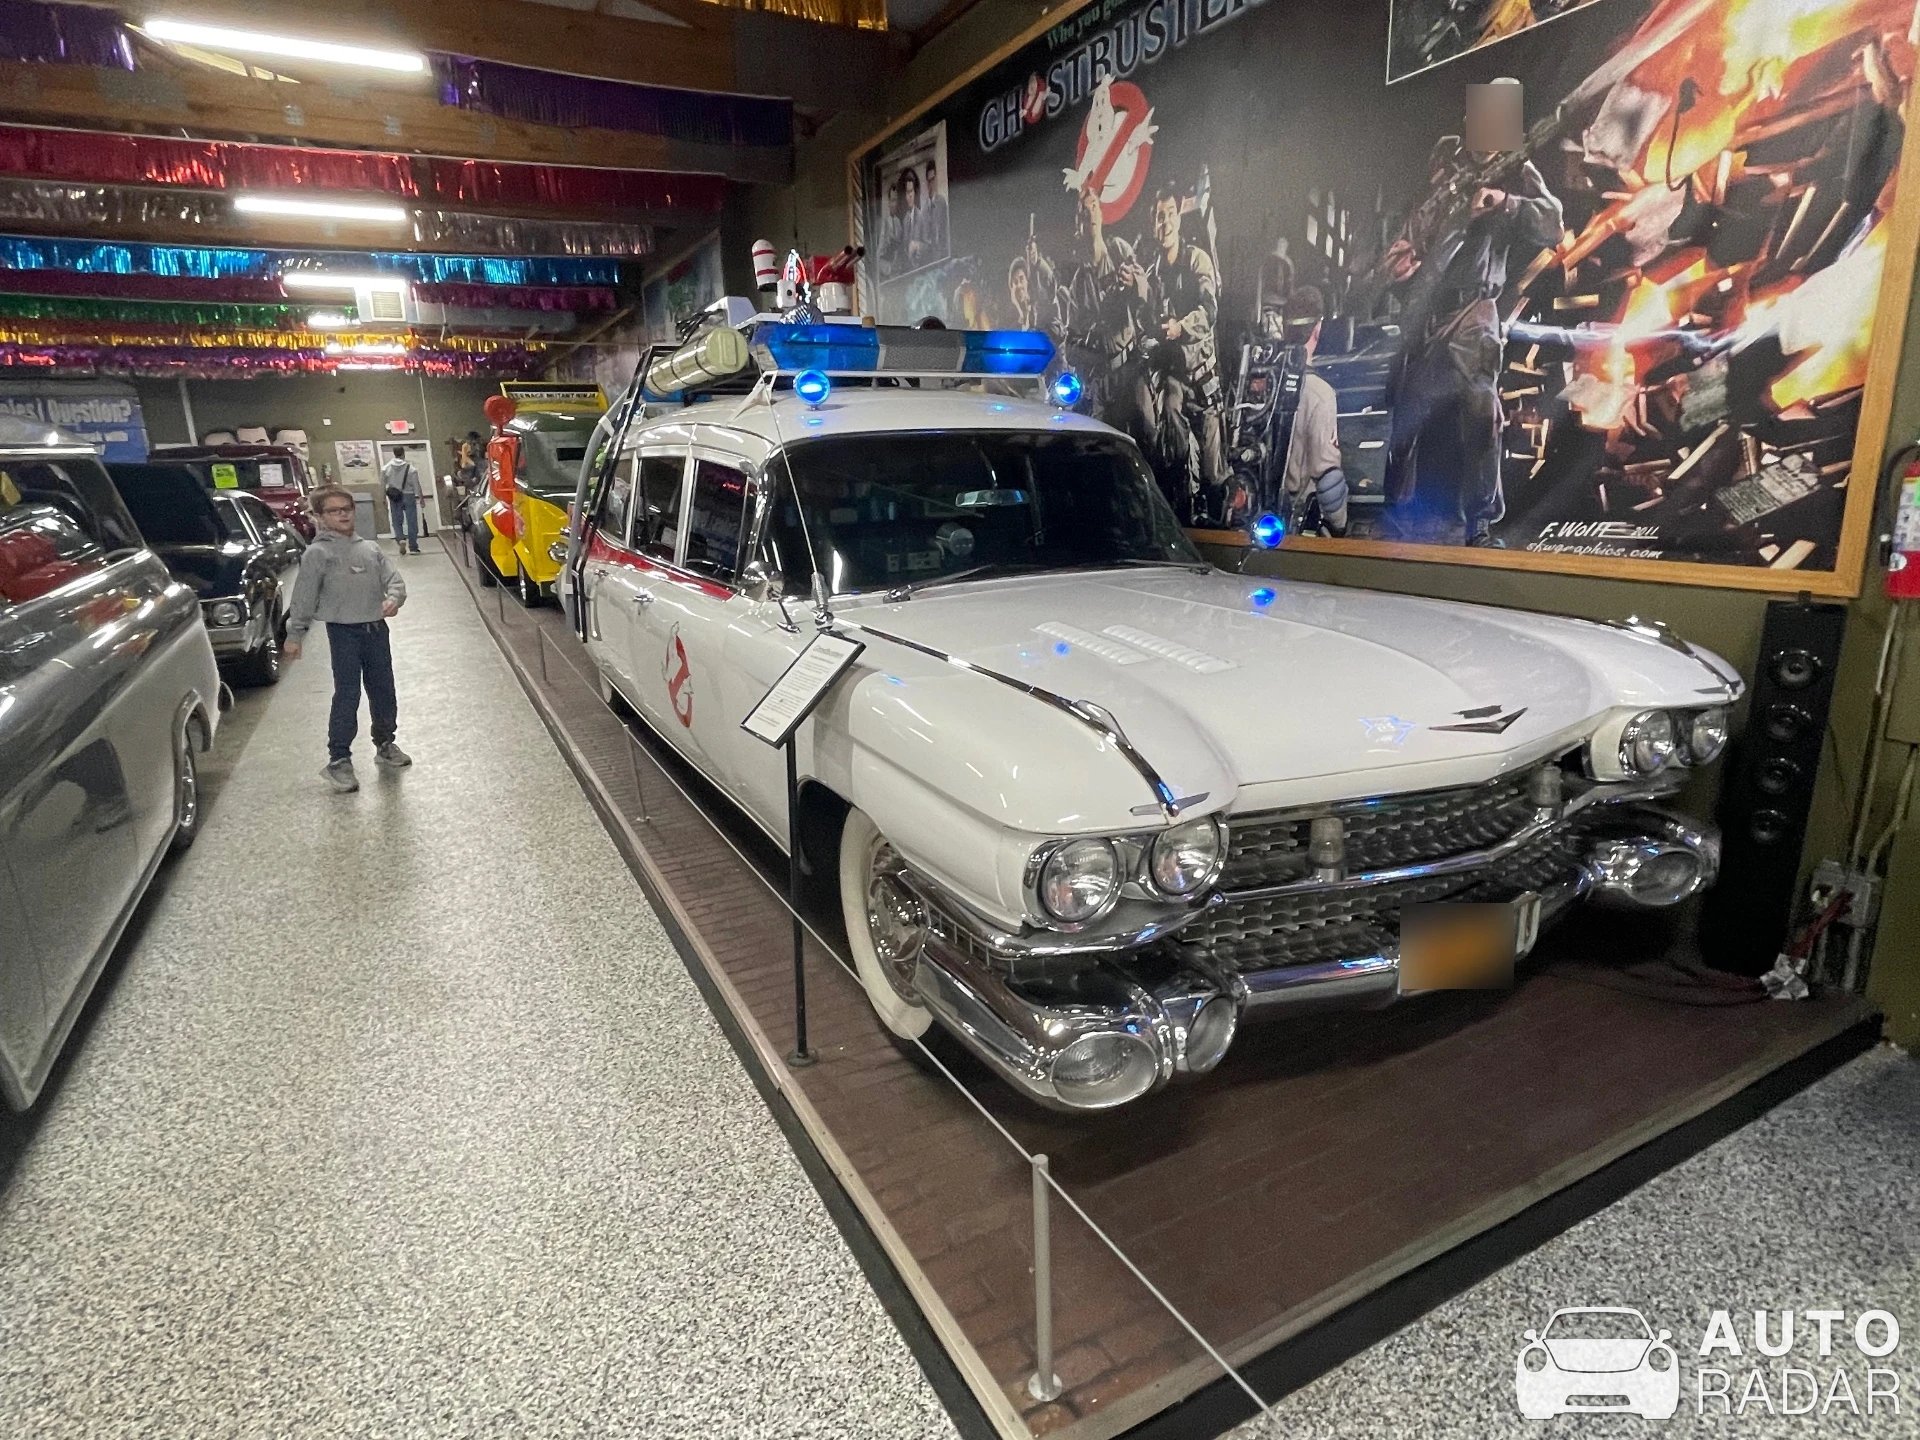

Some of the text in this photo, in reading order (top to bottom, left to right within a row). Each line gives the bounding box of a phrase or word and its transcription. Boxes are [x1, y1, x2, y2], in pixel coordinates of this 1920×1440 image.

[1047, 23, 1075, 50] Who
[1078, 5, 1100, 38] you
[981, 0, 1248, 150] GHOSTBUSTE
[1631, 525, 1660, 537] 2011
